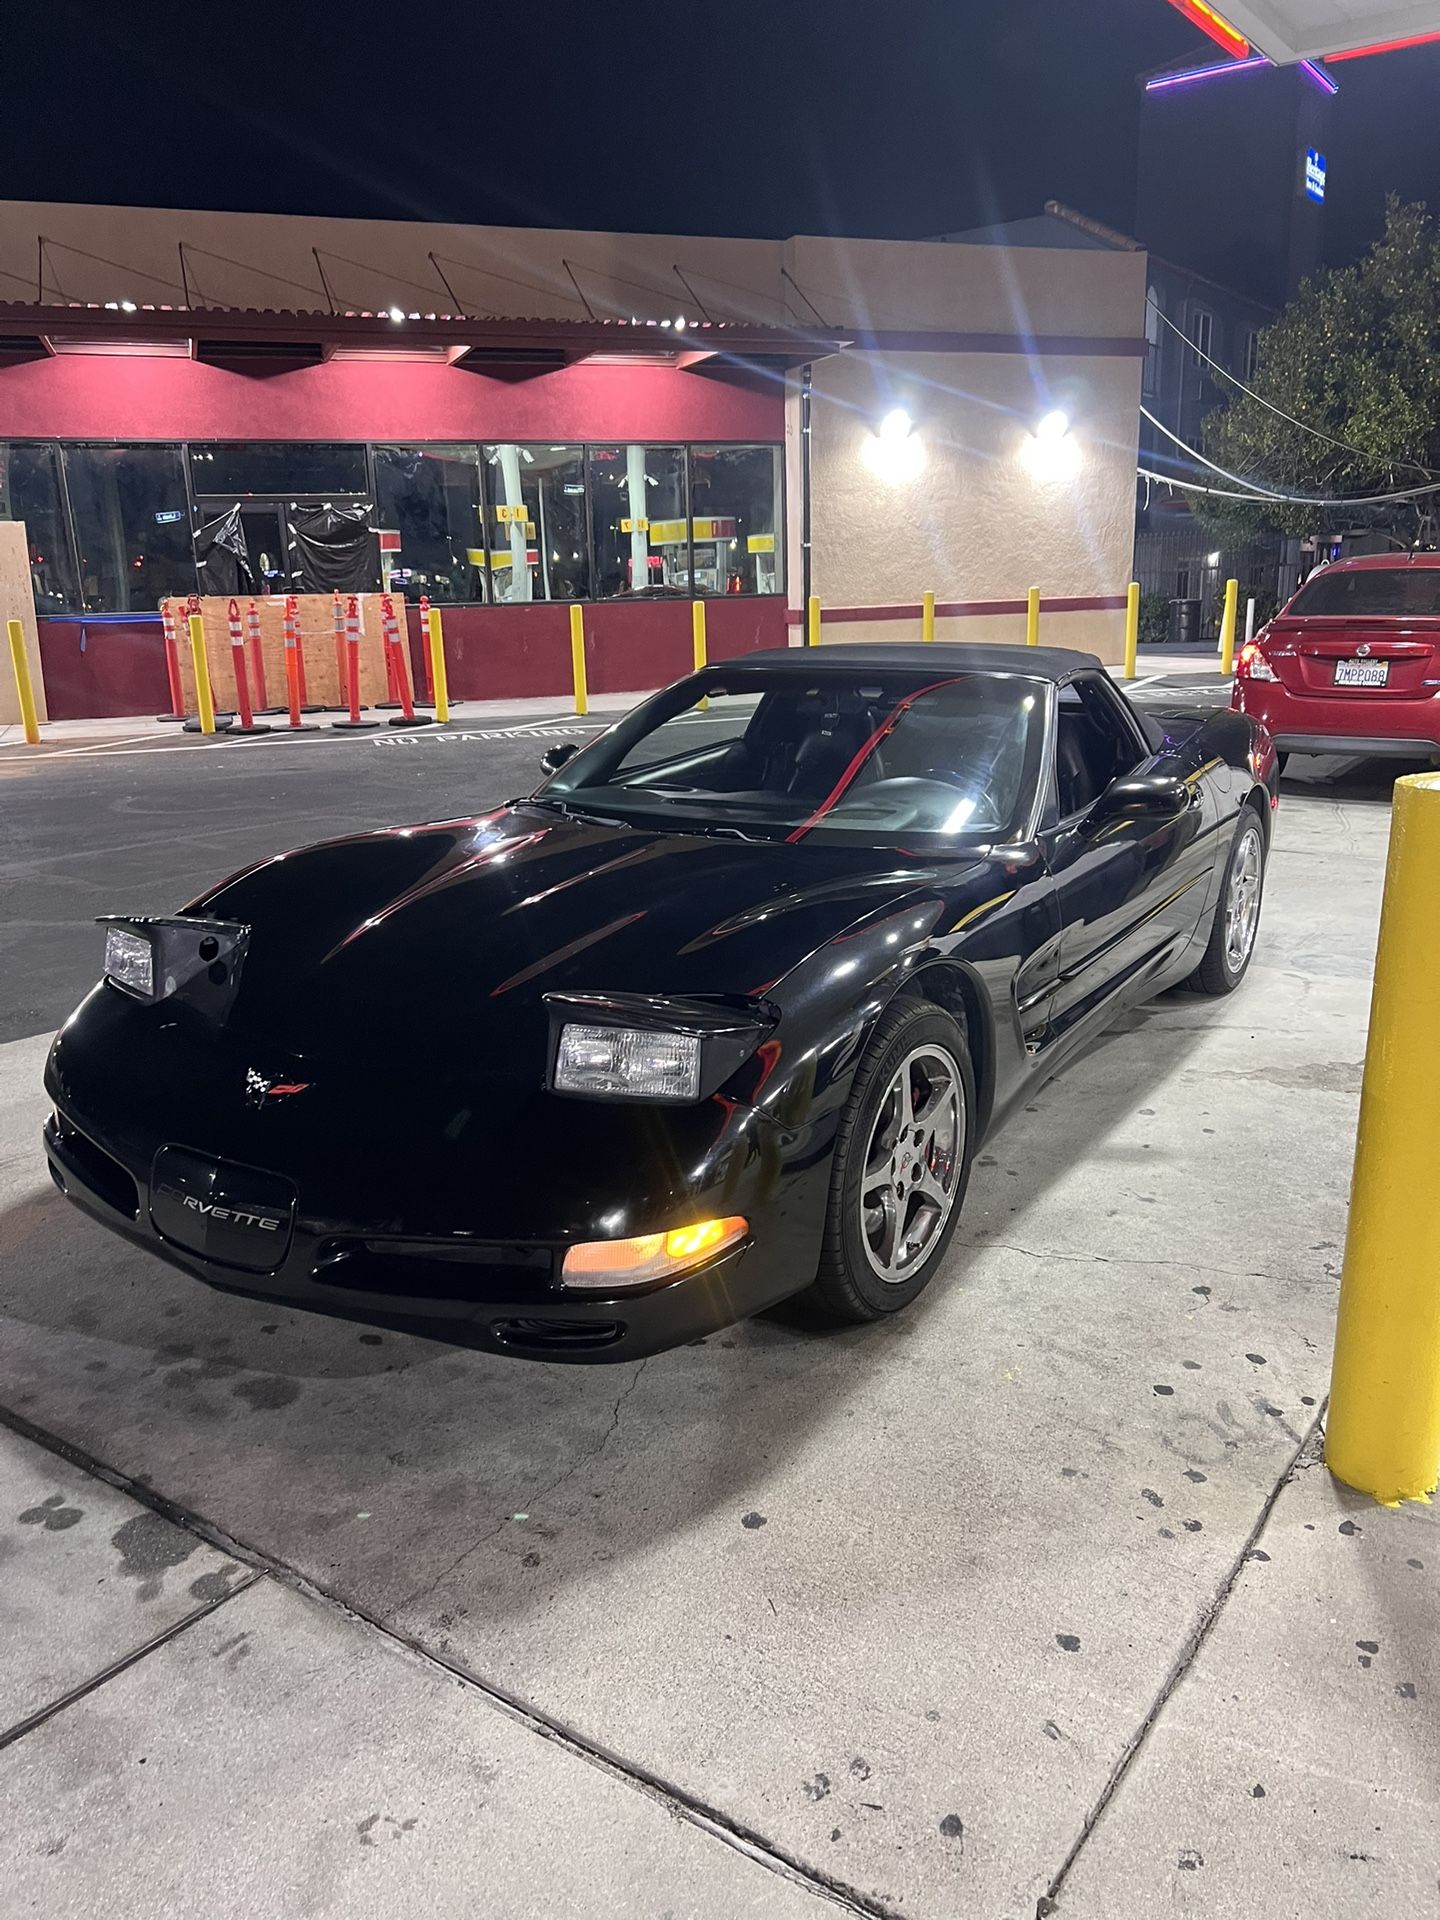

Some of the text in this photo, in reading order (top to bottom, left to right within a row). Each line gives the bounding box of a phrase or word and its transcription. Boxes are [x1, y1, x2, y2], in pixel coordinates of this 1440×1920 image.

[1338, 668, 1386, 682] 7MPP088
[373, 729, 586, 746] NO PARKING
